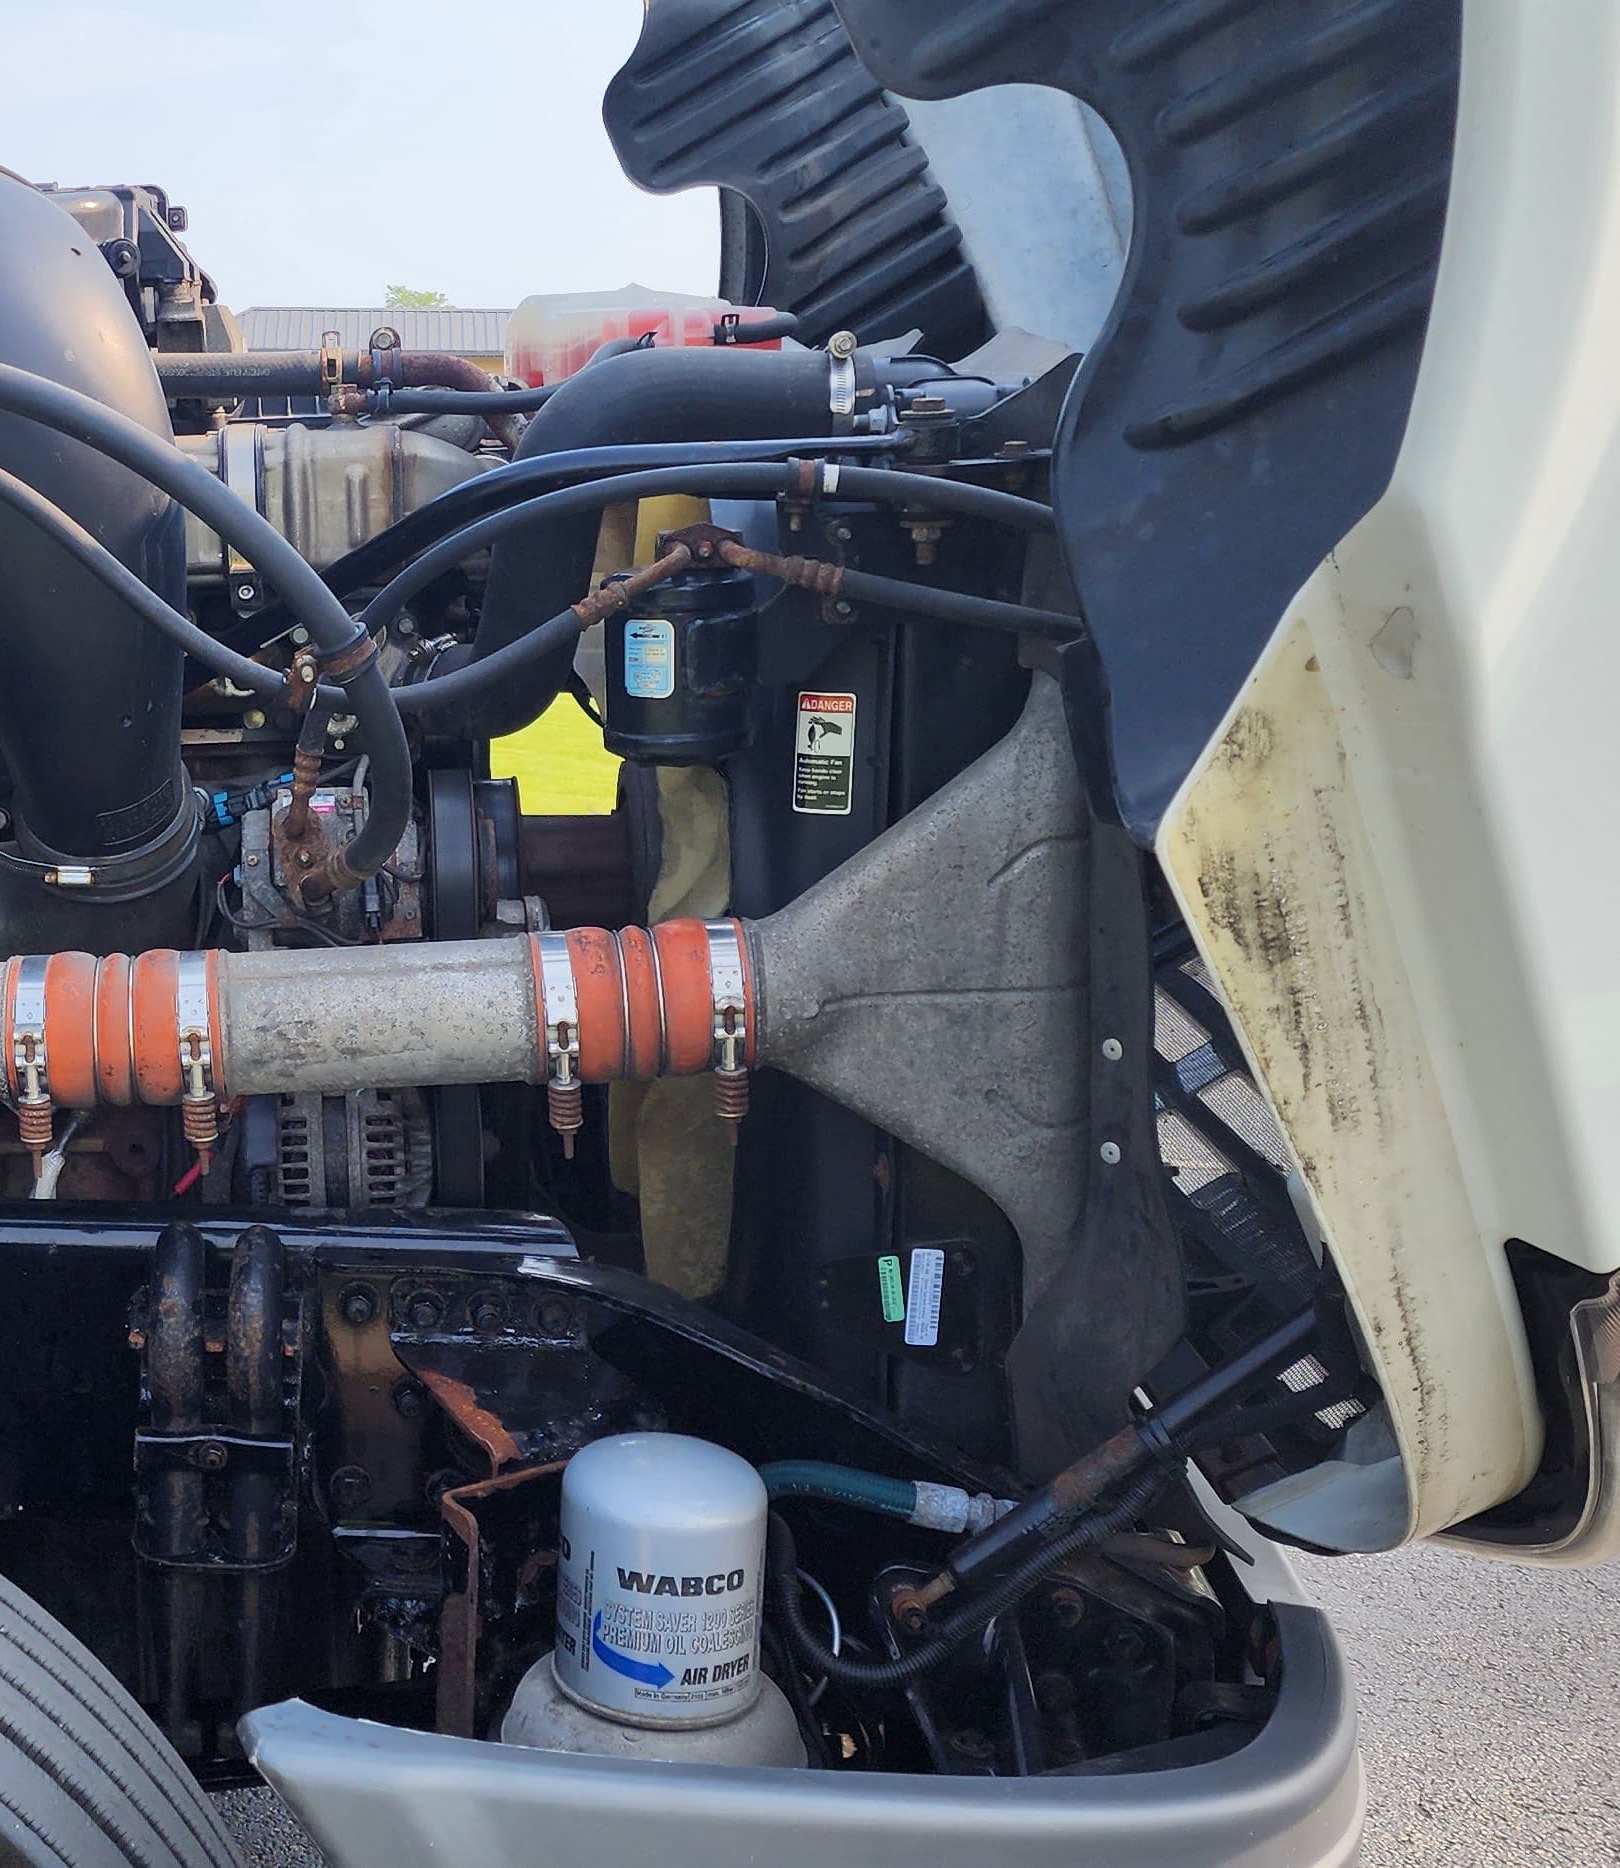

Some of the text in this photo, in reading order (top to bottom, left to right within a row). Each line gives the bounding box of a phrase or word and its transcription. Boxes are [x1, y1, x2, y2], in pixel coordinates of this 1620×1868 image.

[811, 700, 852, 711] DANGER
[617, 1567, 744, 1597] WABCO
[603, 1600, 653, 1631] SYSTEM
[656, 1611, 697, 1633] SAVER
[702, 1607, 728, 1632] 1200
[602, 1623, 661, 1654] PREMIUM
[666, 1634, 687, 1655] OIL
[680, 1653, 750, 1686] AIR DRYER
